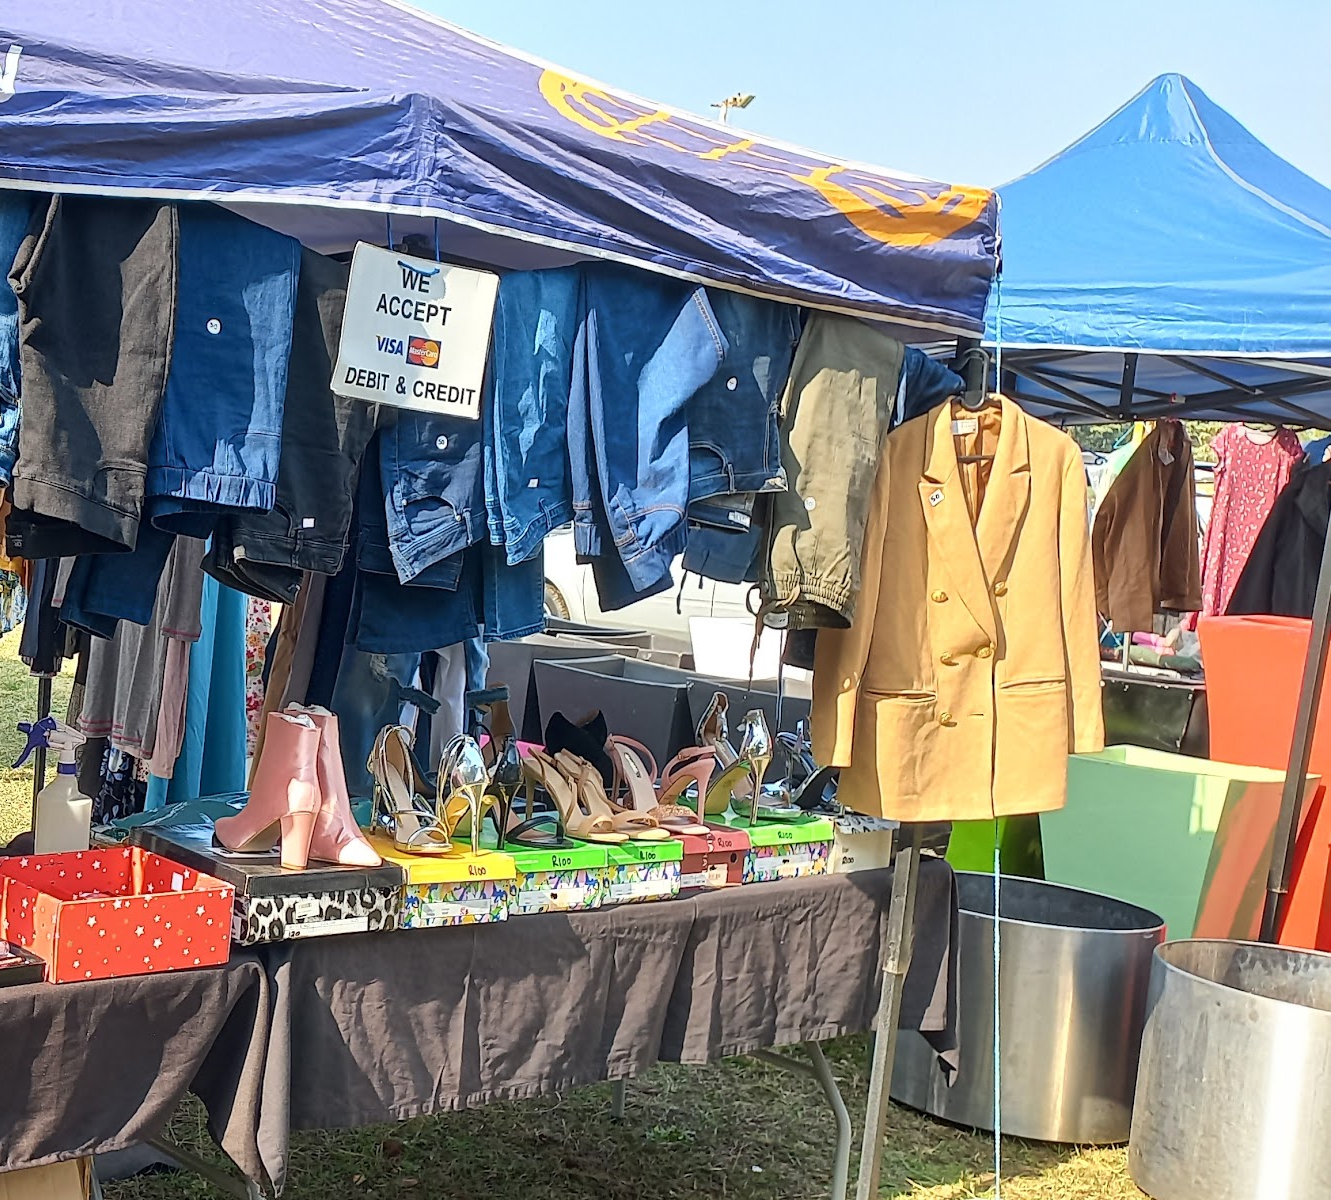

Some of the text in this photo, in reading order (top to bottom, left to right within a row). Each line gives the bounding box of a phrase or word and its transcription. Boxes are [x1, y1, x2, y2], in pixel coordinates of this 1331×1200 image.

[402, 267, 432, 294] WE
[376, 293, 452, 326] ACCEPT
[375, 335, 438, 359] VISA MasterCard
[344, 367, 476, 406] DEBIT & CREDIT
[930, 493, 940, 503] 50
[468, 863, 487, 876] R100
[552, 854, 572, 868] R100
